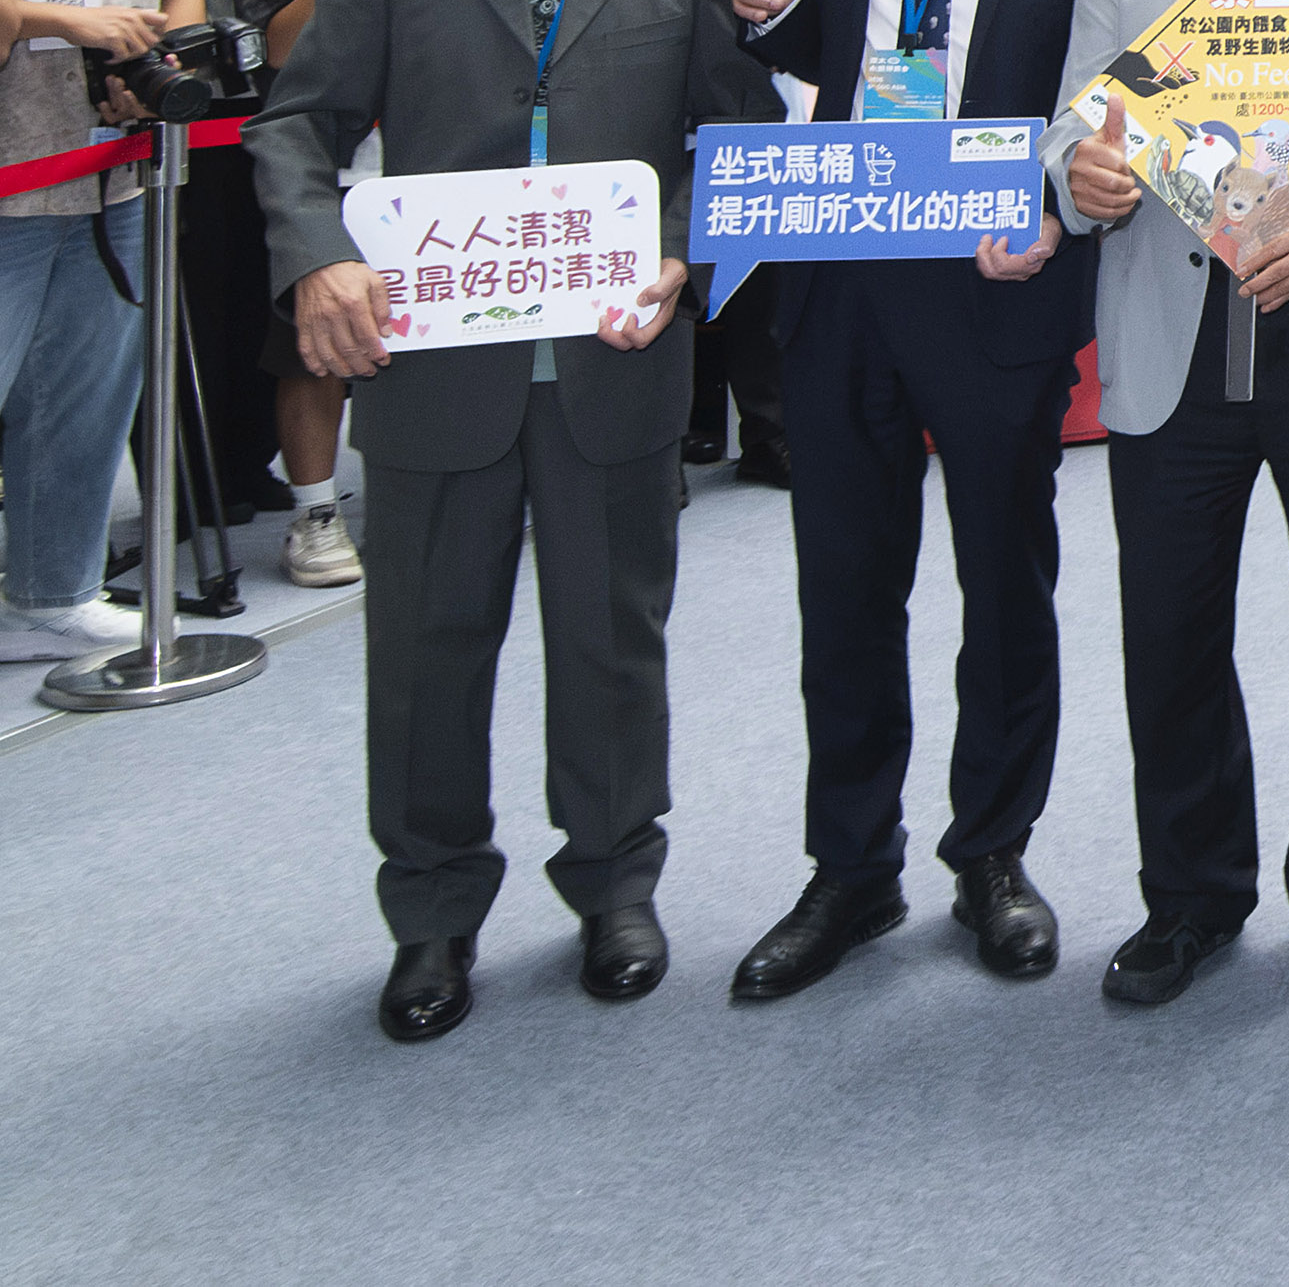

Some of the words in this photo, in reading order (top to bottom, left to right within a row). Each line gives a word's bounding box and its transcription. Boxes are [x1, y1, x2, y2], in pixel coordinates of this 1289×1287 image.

[1204, 64, 1243, 88] No
[708, 143, 854, 186] 坐式馬桶
[414, 209, 592, 256] 人人清潔
[706, 188, 1032, 236] 提升廁所文化的起點
